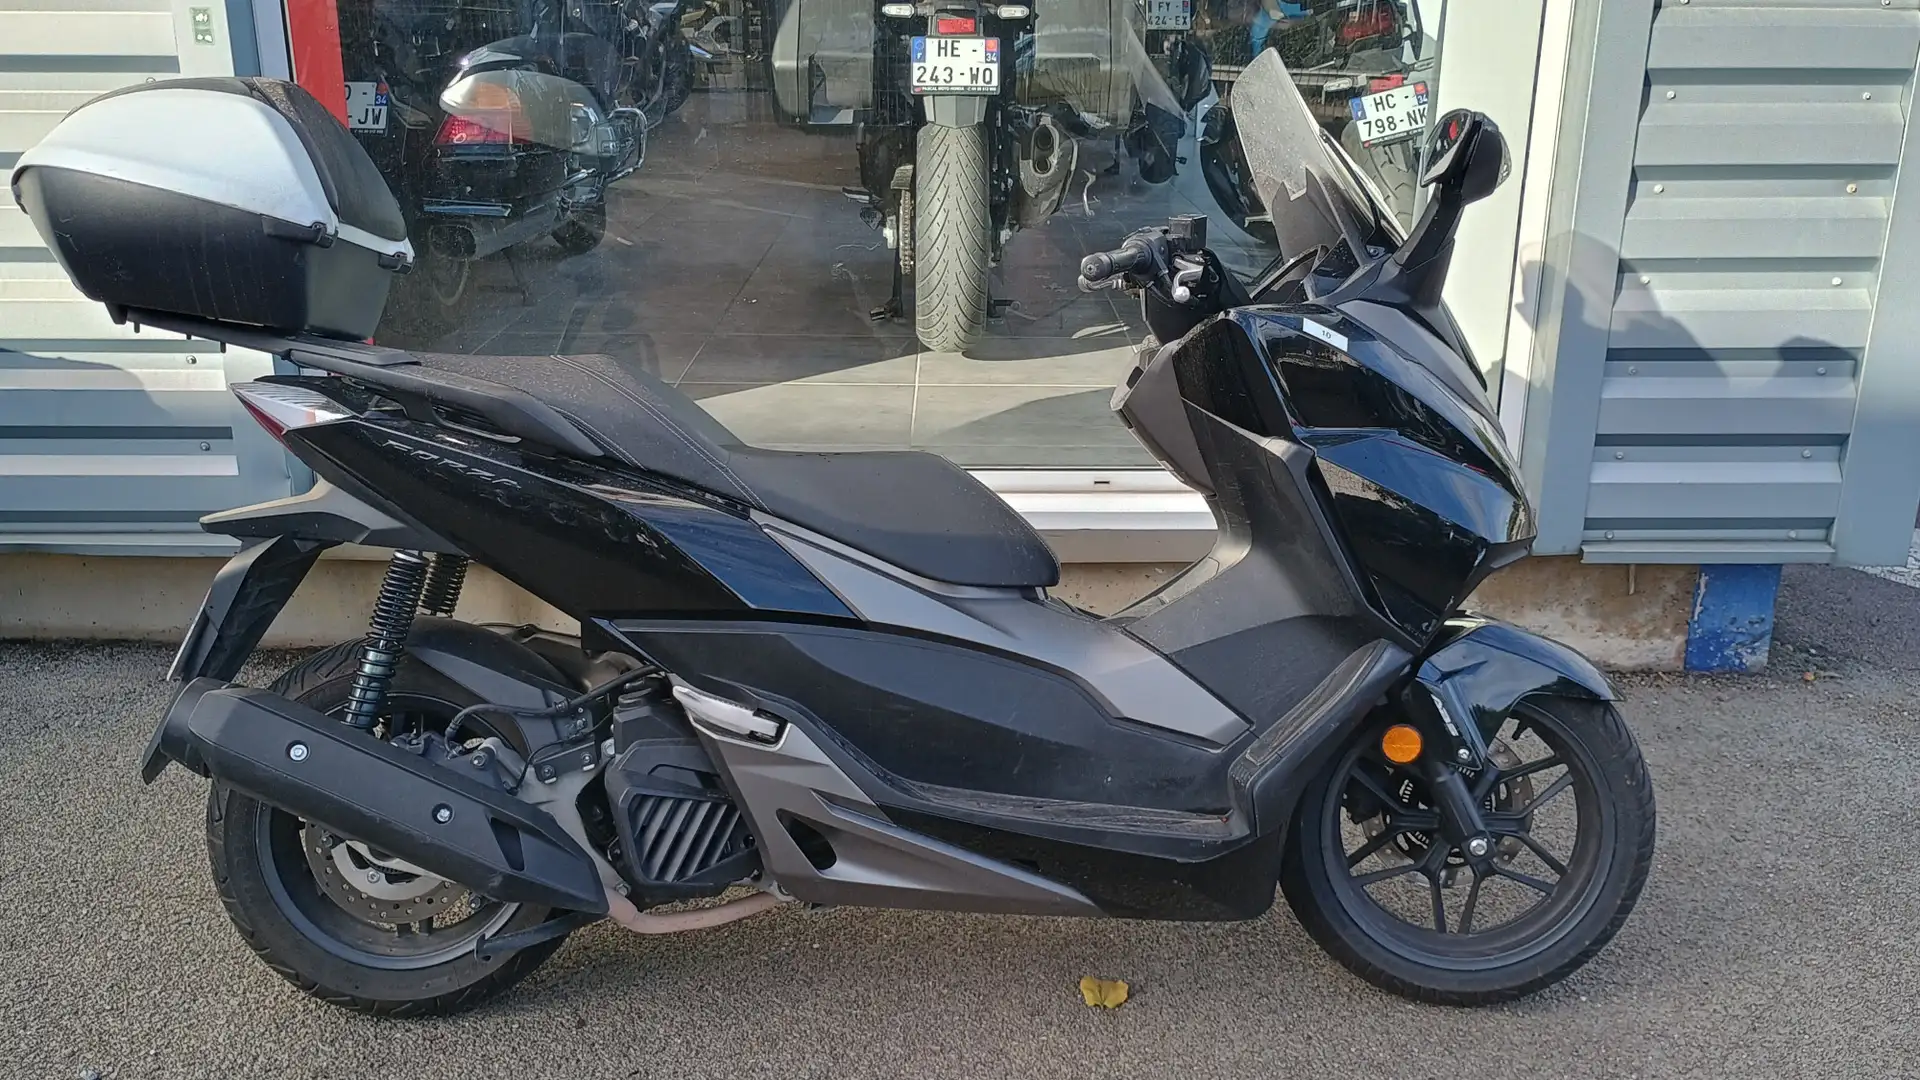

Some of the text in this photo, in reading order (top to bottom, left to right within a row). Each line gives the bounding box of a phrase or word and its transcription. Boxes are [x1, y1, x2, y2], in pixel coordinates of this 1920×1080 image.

[937, 40, 961, 57] HE
[986, 53, 997, 62] 34
[375, 95, 387, 105] 34
[1373, 94, 1396, 112] HC
[1417, 94, 1428, 104] 34
